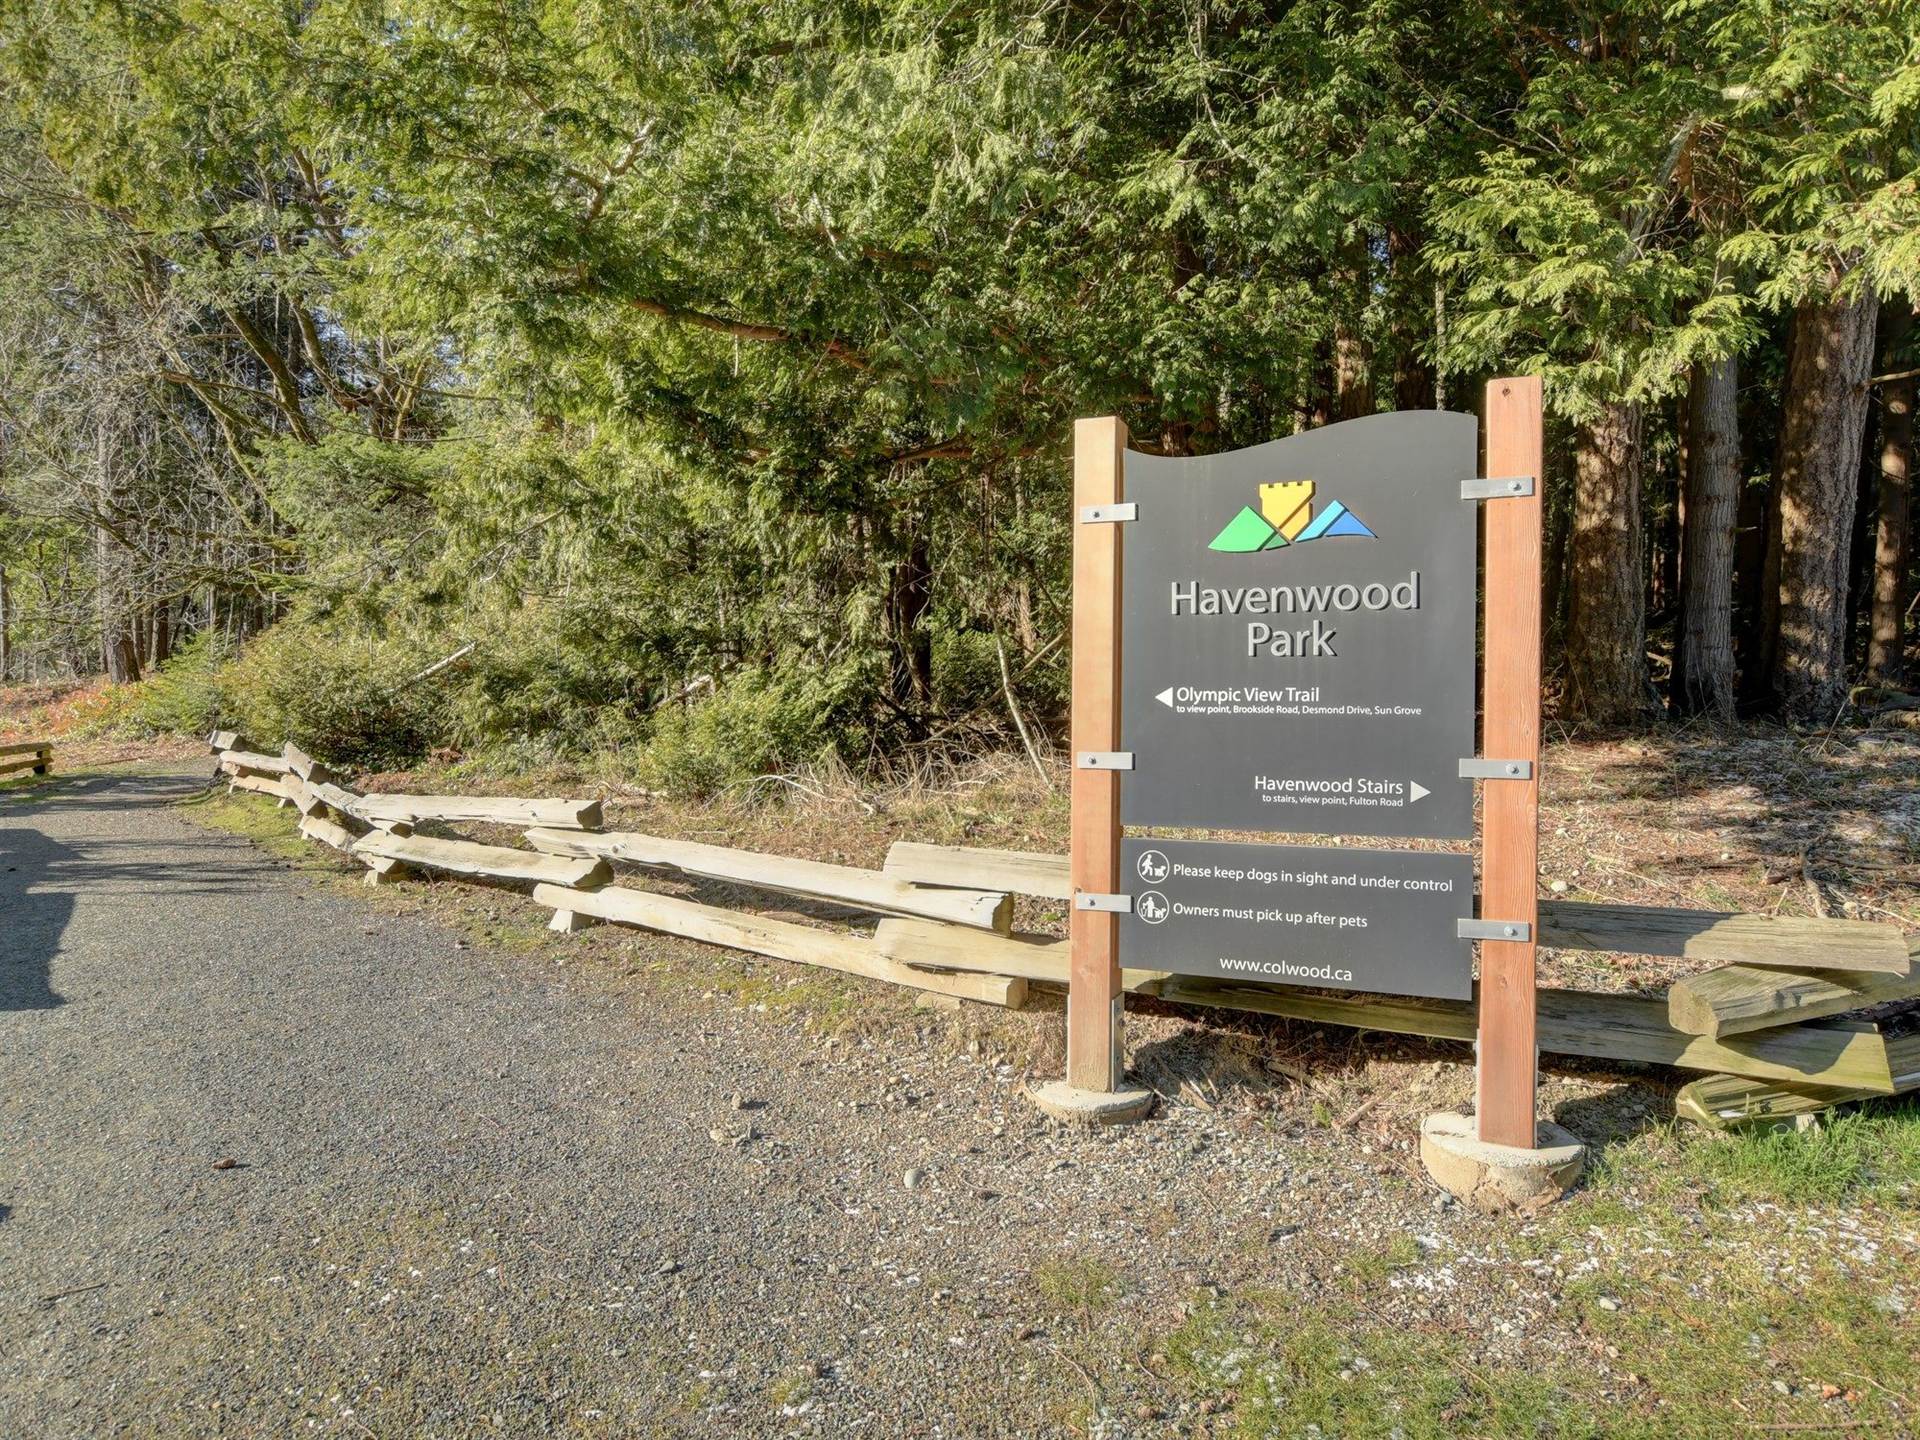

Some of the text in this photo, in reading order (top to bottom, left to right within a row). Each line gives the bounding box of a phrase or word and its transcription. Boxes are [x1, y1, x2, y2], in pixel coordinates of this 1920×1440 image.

[1171, 571, 1419, 615] Havenwood
[1246, 620, 1337, 657] Park
[1176, 686, 1320, 705] Olympic View Trail
[1176, 704, 1422, 716] to view point, Brookside Road, Desmond Drive, Sun Grove
[1254, 775, 1404, 795] Havenwood Stairs
[1262, 794, 1404, 807] to stairs, view point, Fulton Road
[1173, 863, 1453, 892] Please keep dogs in sight and under control
[1172, 902, 1368, 928] Owners must pick up after pets
[1219, 957, 1353, 982] www.colwood.ca
